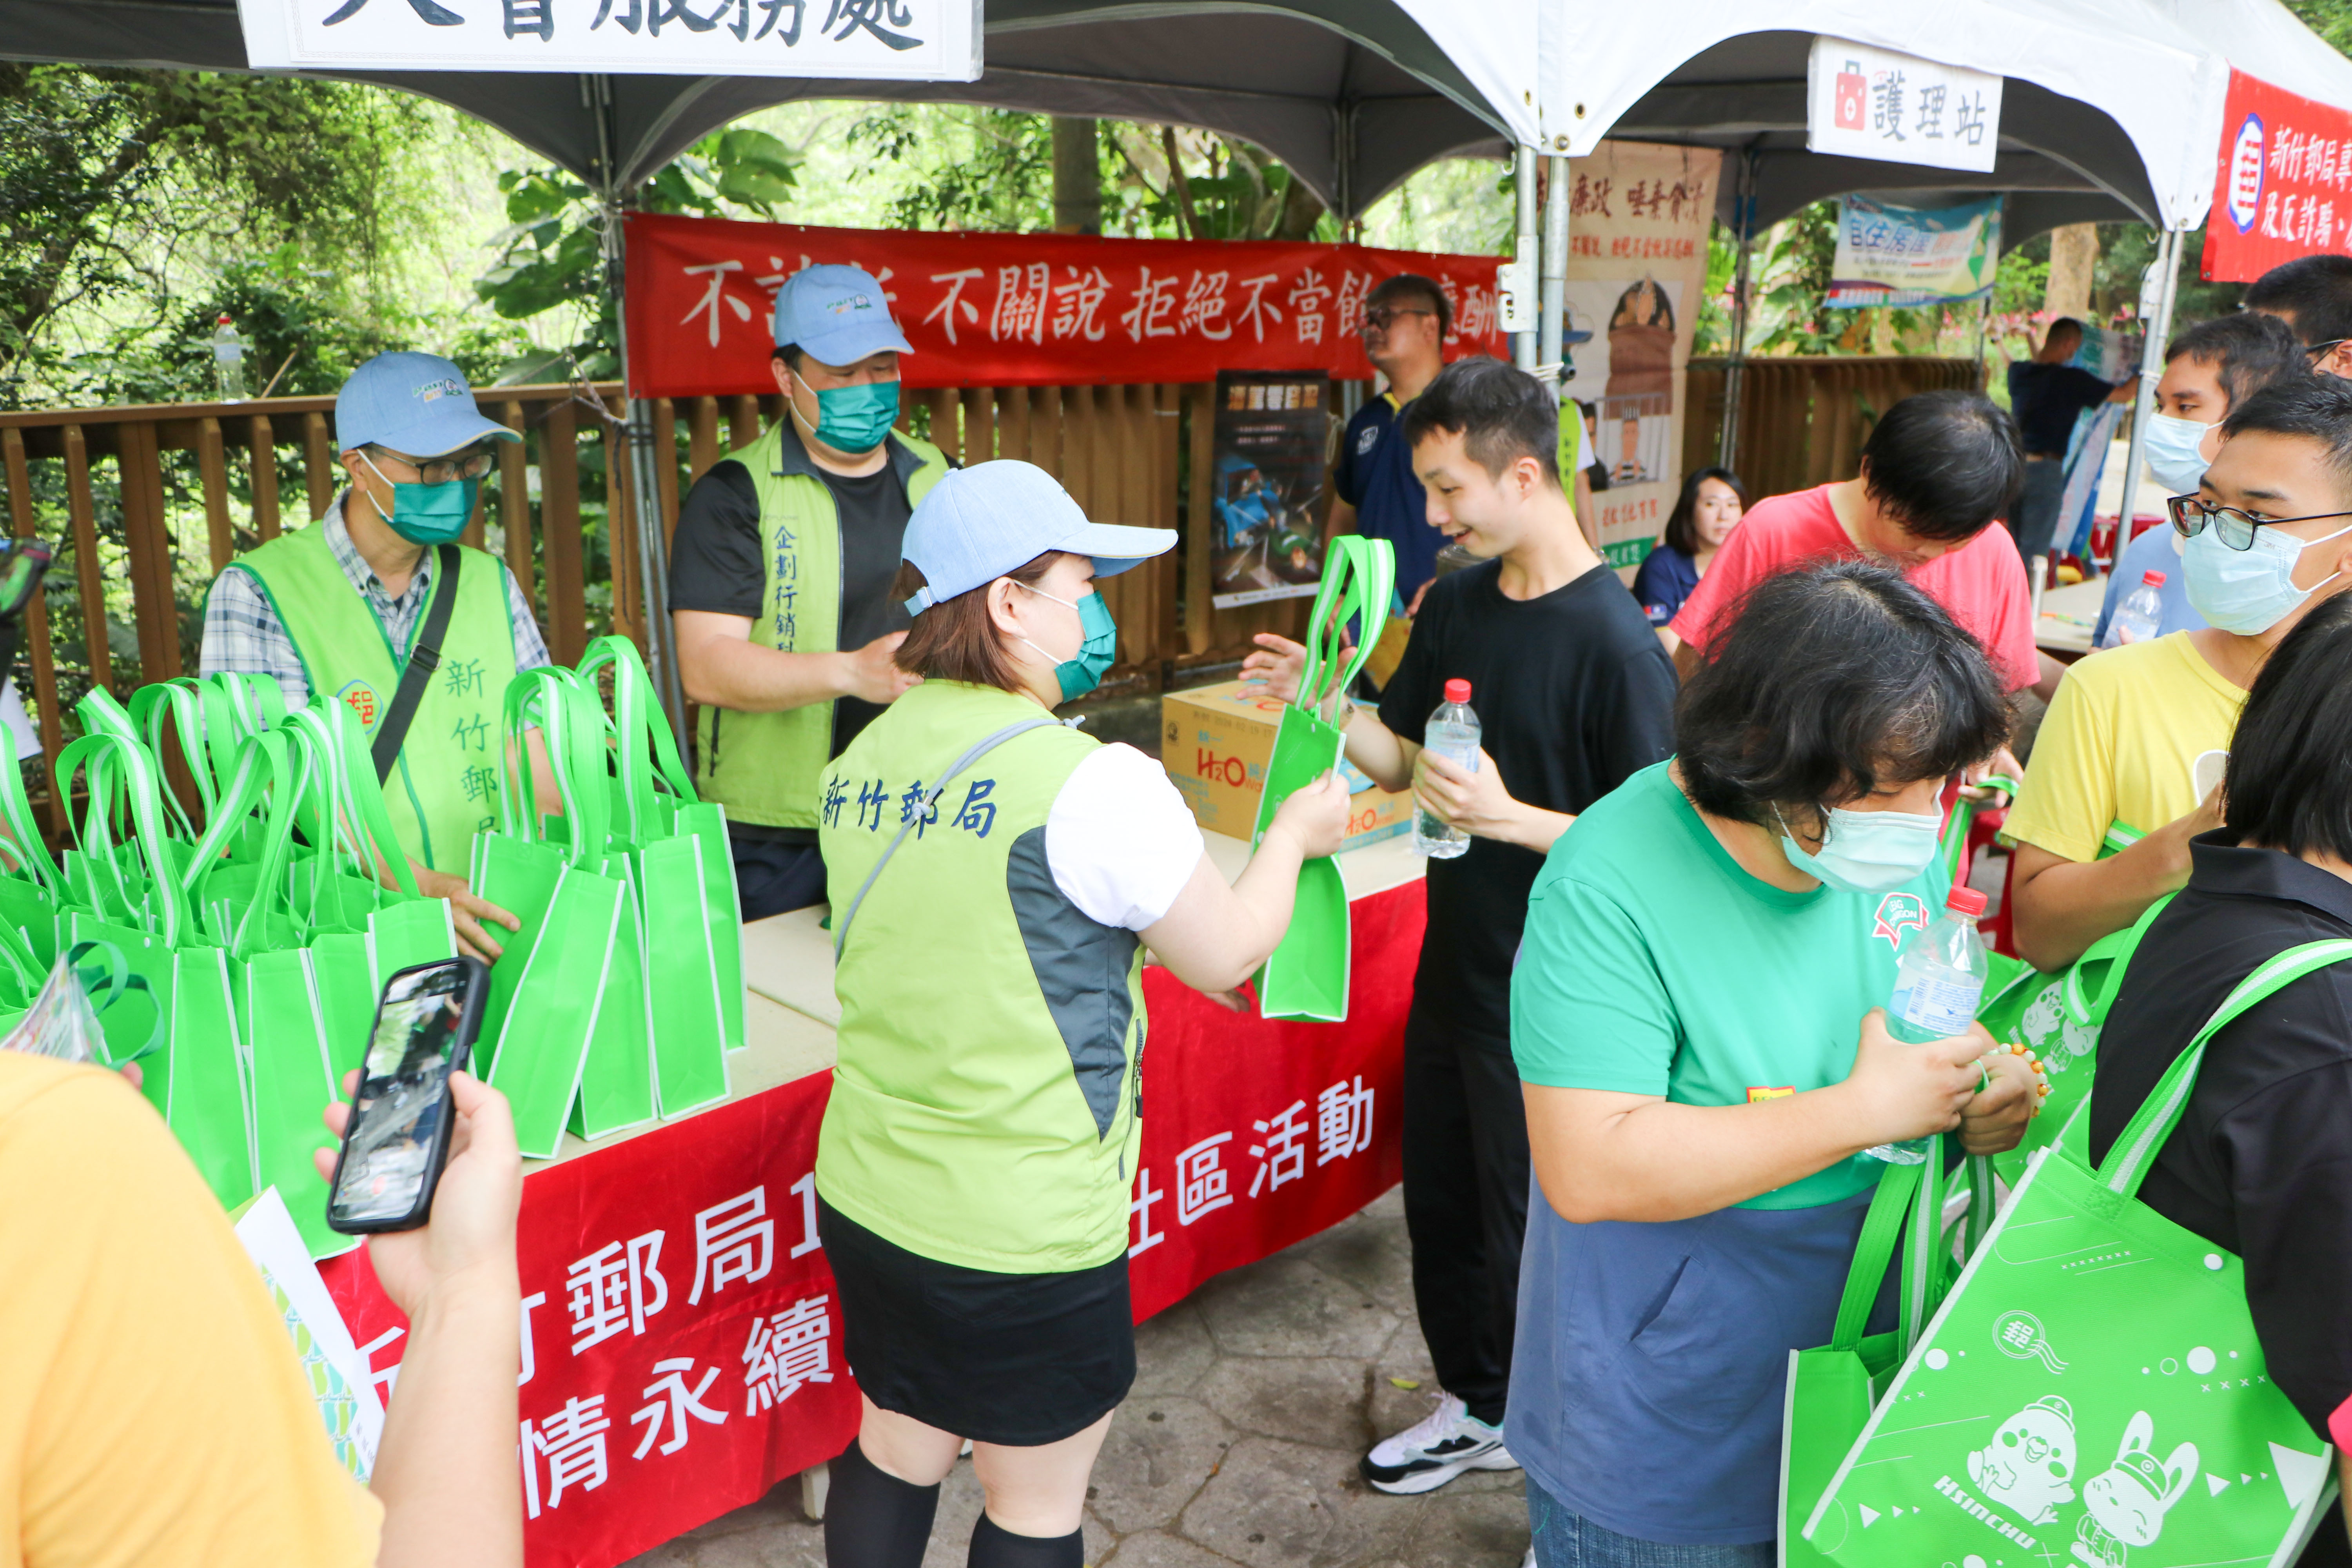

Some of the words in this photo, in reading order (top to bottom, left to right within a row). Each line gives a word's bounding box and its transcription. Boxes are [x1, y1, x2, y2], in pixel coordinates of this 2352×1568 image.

[1873, 70, 1985, 146] 護理站
[824, 773, 996, 840] 新竹郵局
[1933, 1475, 2037, 1549] HSINCHU
